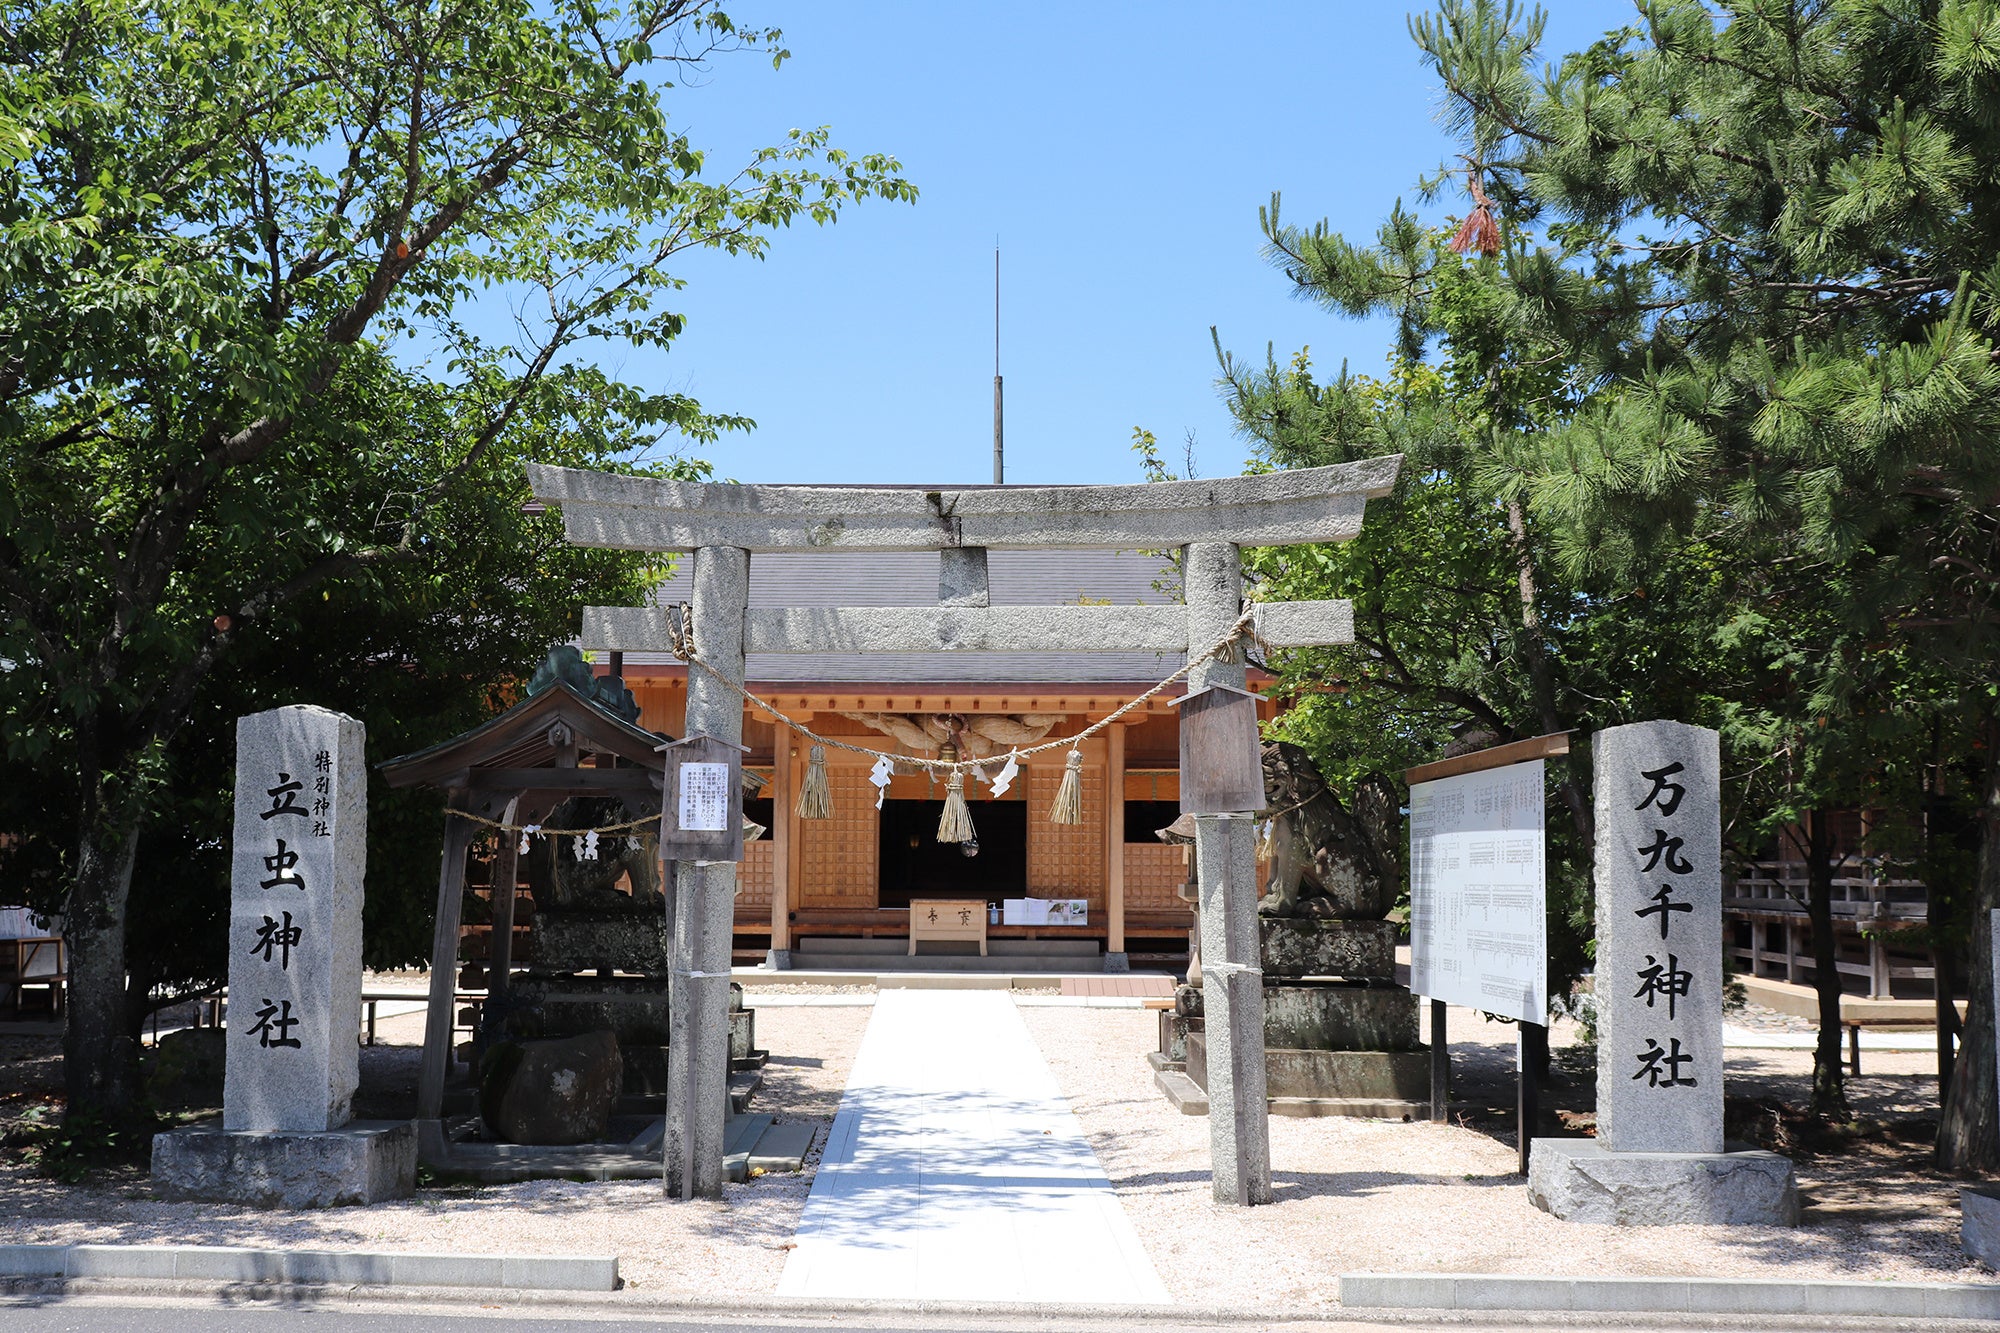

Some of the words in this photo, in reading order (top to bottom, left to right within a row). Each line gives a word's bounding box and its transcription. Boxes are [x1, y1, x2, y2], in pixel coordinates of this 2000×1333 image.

[245, 772, 310, 1050] 立虫神社
[312, 750, 333, 838] 特別神社
[1632, 761, 1698, 1089] 万九千神社
